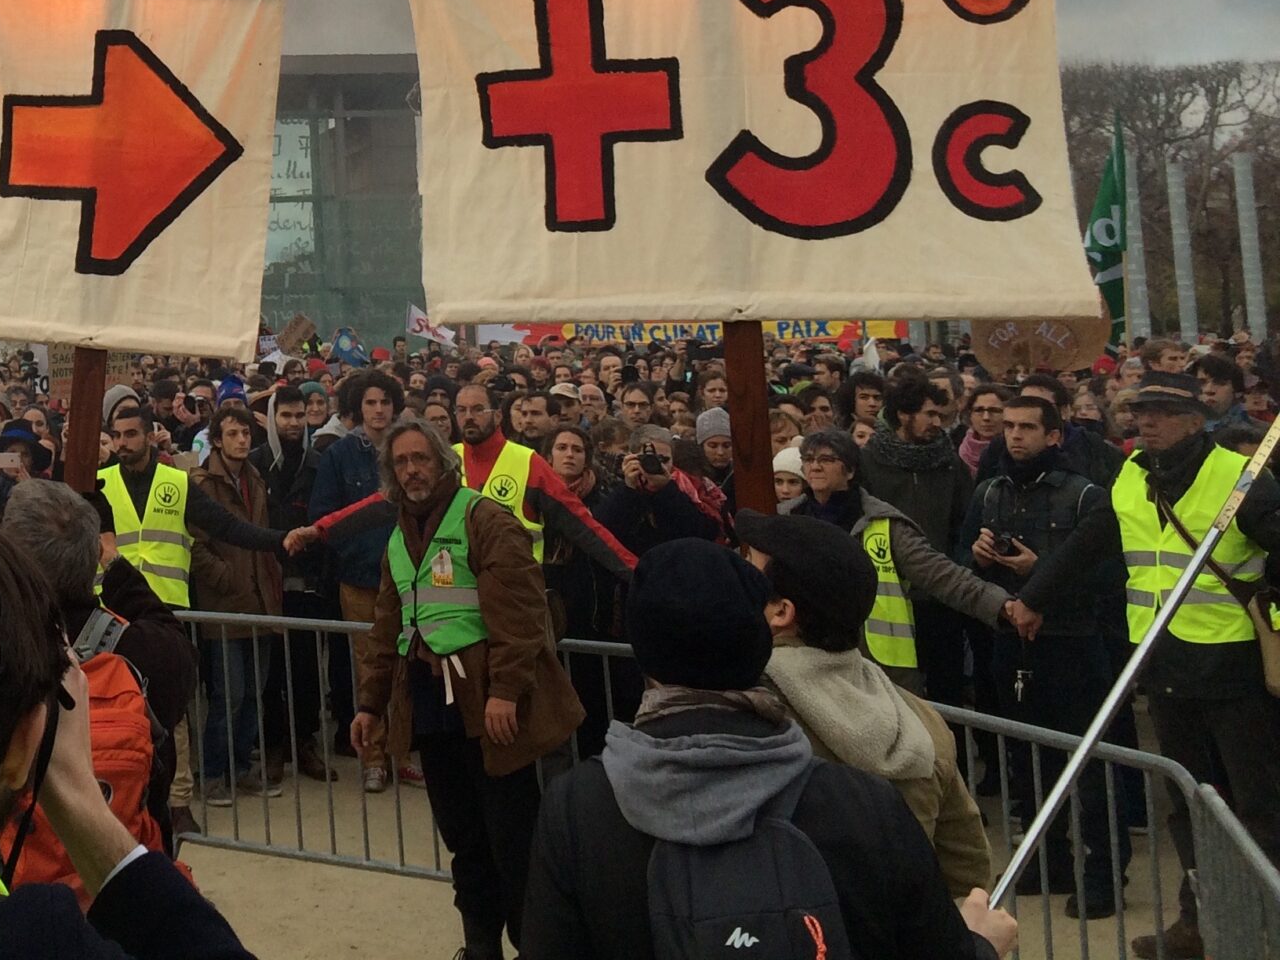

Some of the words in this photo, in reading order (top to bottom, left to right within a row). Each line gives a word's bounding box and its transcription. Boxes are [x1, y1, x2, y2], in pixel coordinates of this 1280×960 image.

[574, 323, 616, 342] POUR
[620, 323, 644, 342] UN
[777, 320, 830, 340] PAIX
[988, 321, 1019, 349] FOR
[1034, 321, 1072, 349] ALL
